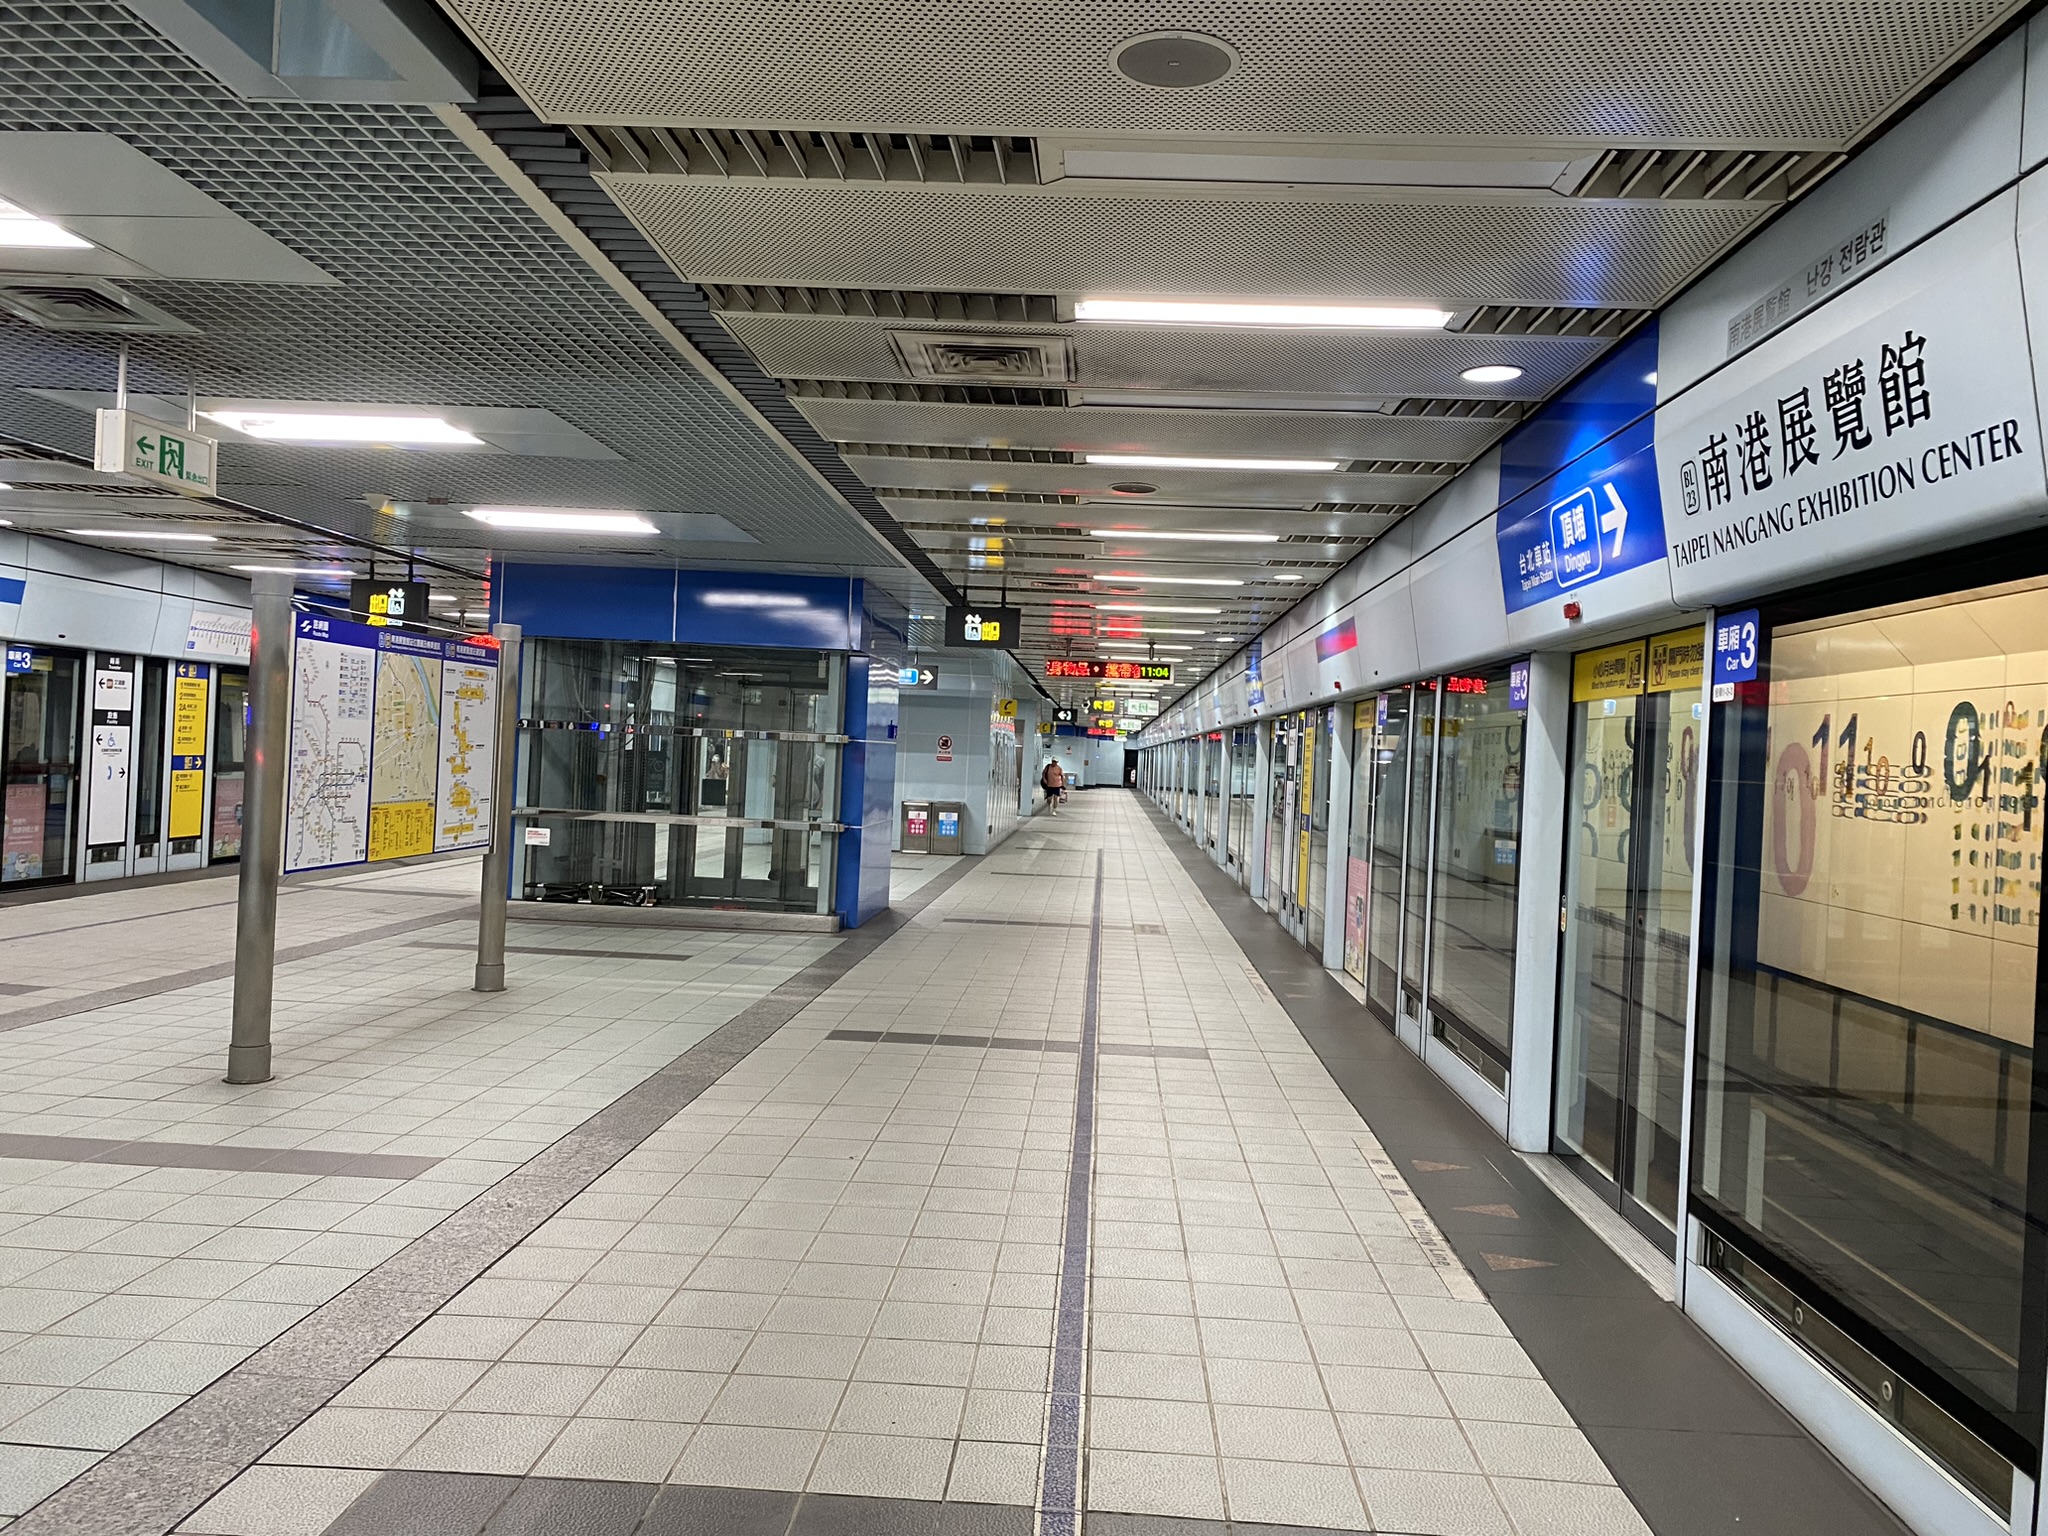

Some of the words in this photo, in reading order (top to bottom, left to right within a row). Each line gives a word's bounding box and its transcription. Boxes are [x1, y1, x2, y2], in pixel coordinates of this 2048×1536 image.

[1807, 255, 1833, 297] 난강
[1839, 219, 1886, 274] 전람관
[1698, 330, 1930, 512] 南港展覽館
[135, 457, 154, 470] EXIT
[1672, 533, 1710, 568] TAIPEI
[1713, 502, 1794, 554] NANGANG
[1797, 457, 1915, 527] EXHIBITION
[1921, 419, 2023, 486] CENTER
[1683, 471, 1694, 488] BL
[1686, 490, 1697, 508] 23
[1519, 541, 1552, 576] 台北車站
[1564, 550, 1592, 573] Dingpu
[1717, 625, 1740, 653] 車廂
[1741, 622, 1756, 669] 3
[22, 652, 31, 669] 3
[1141, 666, 1169, 678] 11:04
[1726, 657, 1739, 671] Car
[1521, 669, 1529, 700] 3
[1409, 1218, 1437, 1247] Waiting
[1429, 1248, 1451, 1267] Line
